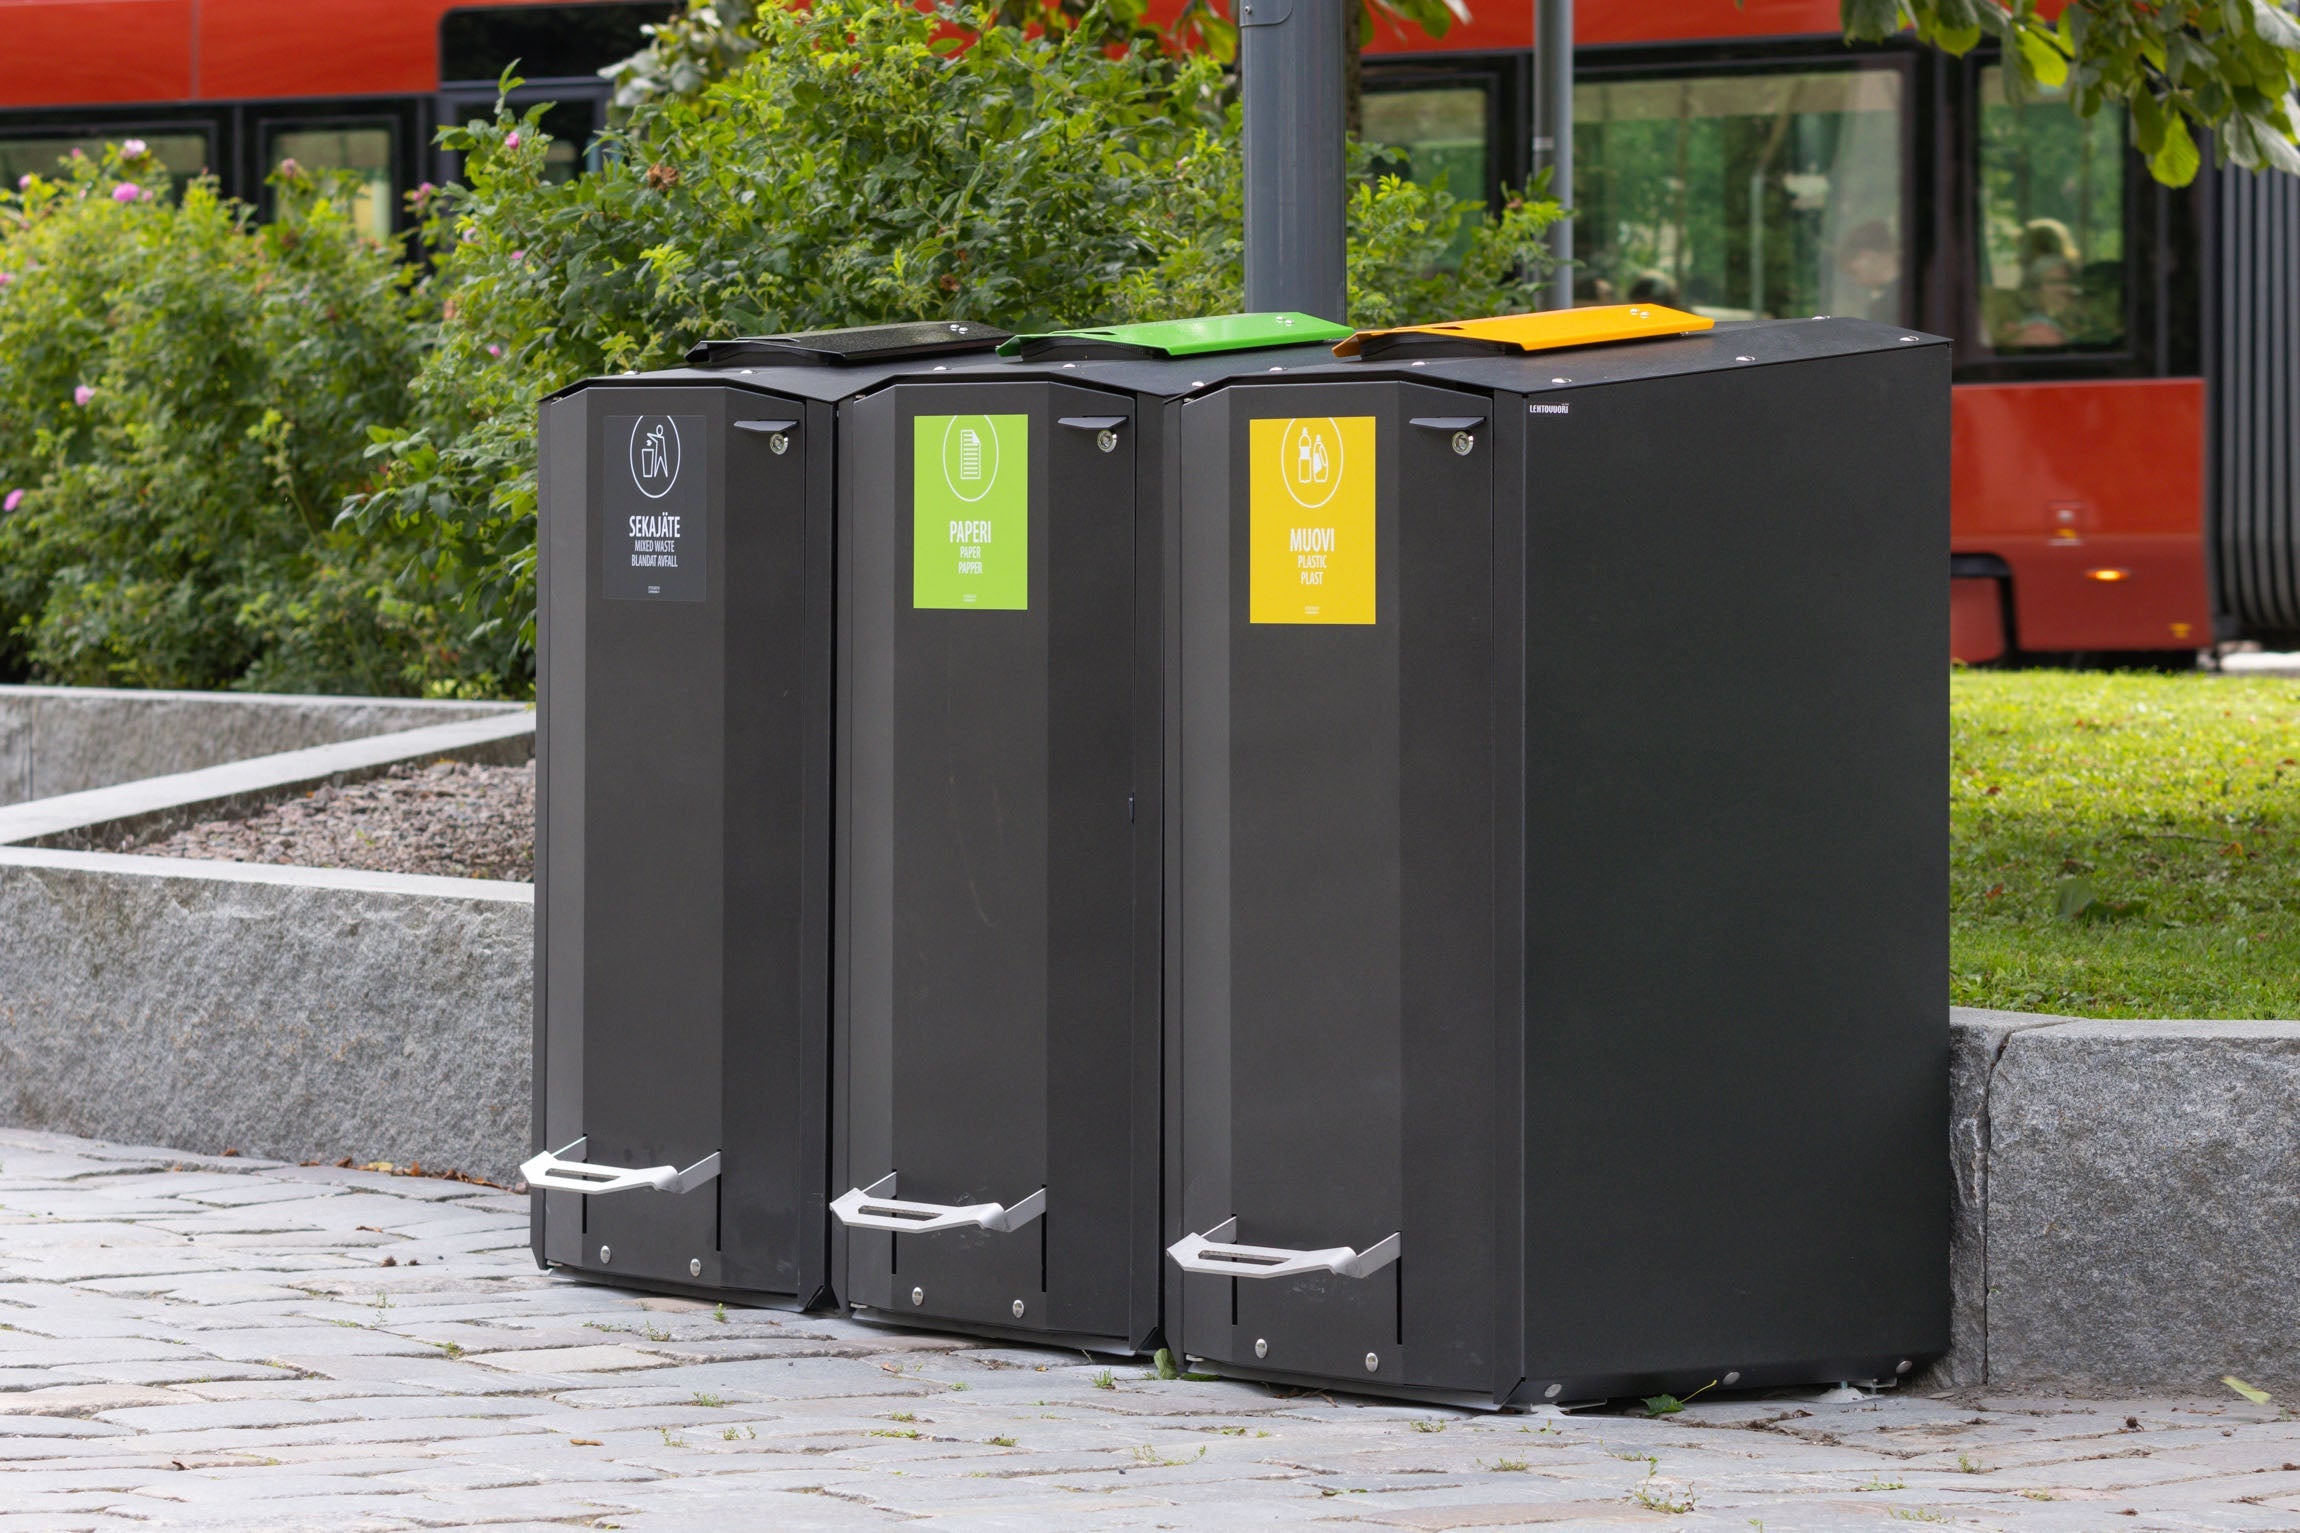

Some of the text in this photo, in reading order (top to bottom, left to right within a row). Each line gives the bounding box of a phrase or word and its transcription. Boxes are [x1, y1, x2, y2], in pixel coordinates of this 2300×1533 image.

[629, 512, 680, 538] SEKAJÄTE
[950, 520, 991, 543] PAPERI
[635, 540, 675, 553] MIXED WASTE
[1289, 528, 1334, 552] MUOVI
[960, 546, 981, 559] PAPER
[632, 554, 678, 568] BLANDAT AVFALL
[958, 561, 983, 575] PAPPER
[1298, 555, 1327, 569] PLASTIC
[1301, 571, 1324, 585] PLAST
